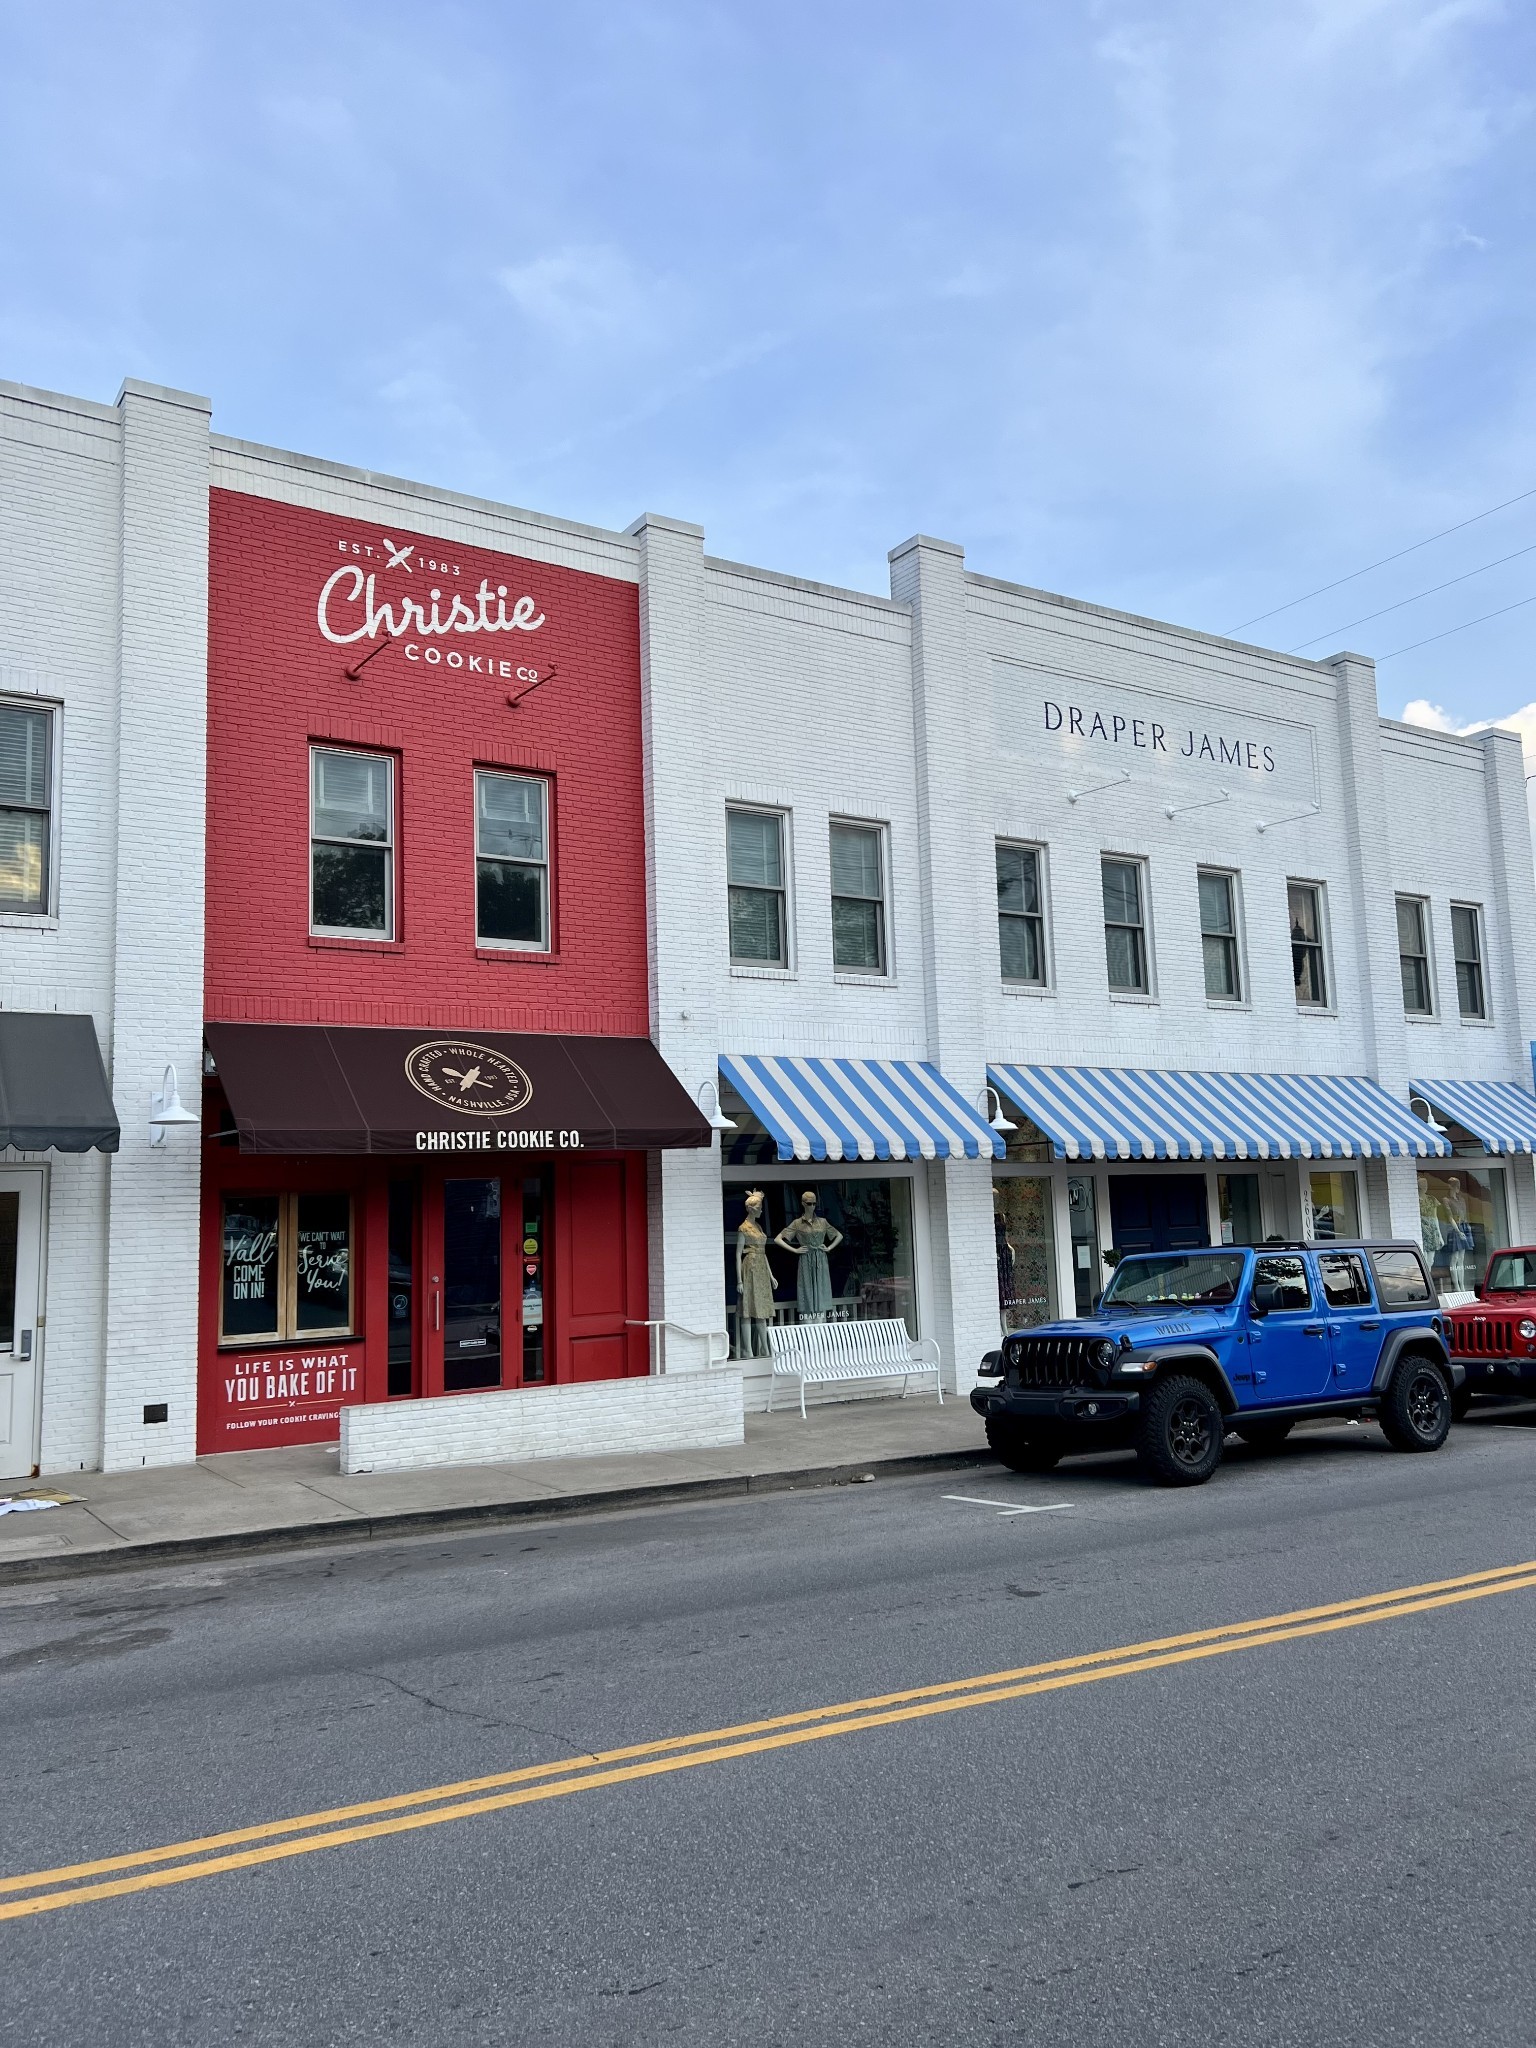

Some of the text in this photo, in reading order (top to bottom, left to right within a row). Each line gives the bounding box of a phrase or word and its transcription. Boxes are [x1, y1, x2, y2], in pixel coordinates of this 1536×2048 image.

[338, 540, 461, 576] EST. 1983
[317, 565, 546, 644] Christie
[404, 644, 512, 678] COOKIE
[1044, 701, 1275, 772] DRAPER JAMES
[418, 1047, 519, 1092] HAND CRAFTED WHOLE HEARTED
[448, 1089, 521, 1109] NASHVILLE, USA
[415, 1130, 585, 1150] CHRISTIE COOKIE CO.
[300, 1231, 346, 1242] WE CAN'T WAIT
[320, 1242, 327, 1250] TO
[226, 1232, 274, 1266] Y'all
[297, 1244, 349, 1275] Serve
[233, 1265, 266, 1283] COME
[307, 1268, 346, 1293] You!
[233, 1281, 265, 1300] ON IN!
[1004, 1298, 1027, 1306] DRAPER
[799, 1310, 850, 1321] DRAPER JAMES
[1153, 1322, 1192, 1336] WILLYS
[235, 1354, 349, 1376] LIFE IS WHAT
[225, 1368, 357, 1403] YOU BAKE OF IT
[226, 1421, 257, 1430] FOLLOW
[257, 1418, 278, 1426] YOUR
[280, 1415, 307, 1424] COOKIE
